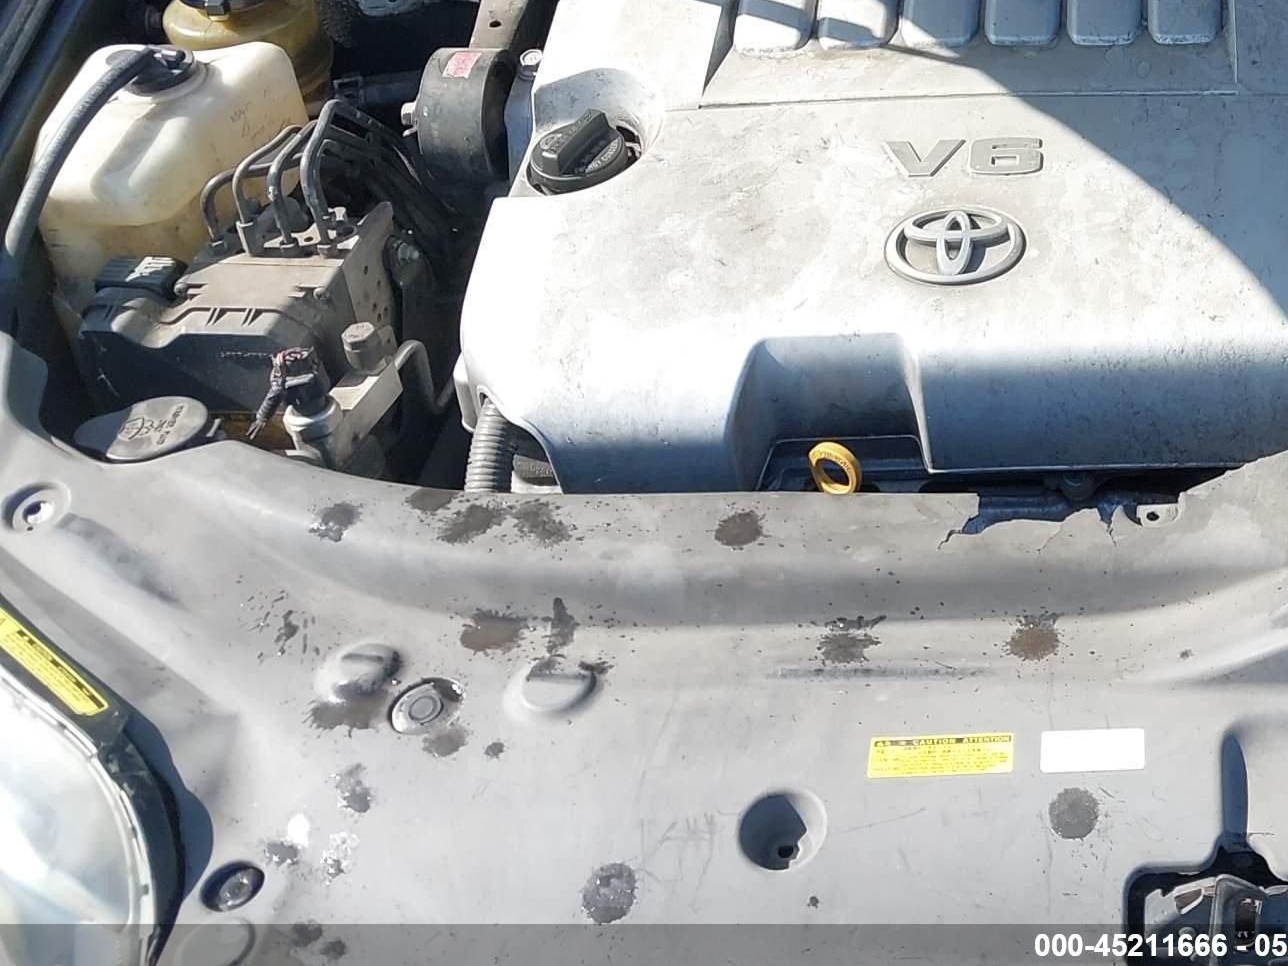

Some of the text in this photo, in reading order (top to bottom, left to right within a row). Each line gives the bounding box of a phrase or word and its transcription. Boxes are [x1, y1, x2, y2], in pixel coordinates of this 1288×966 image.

[881, 137, 1044, 177] V6
[912, 735, 1010, 746] CAUTION ATTENTION
